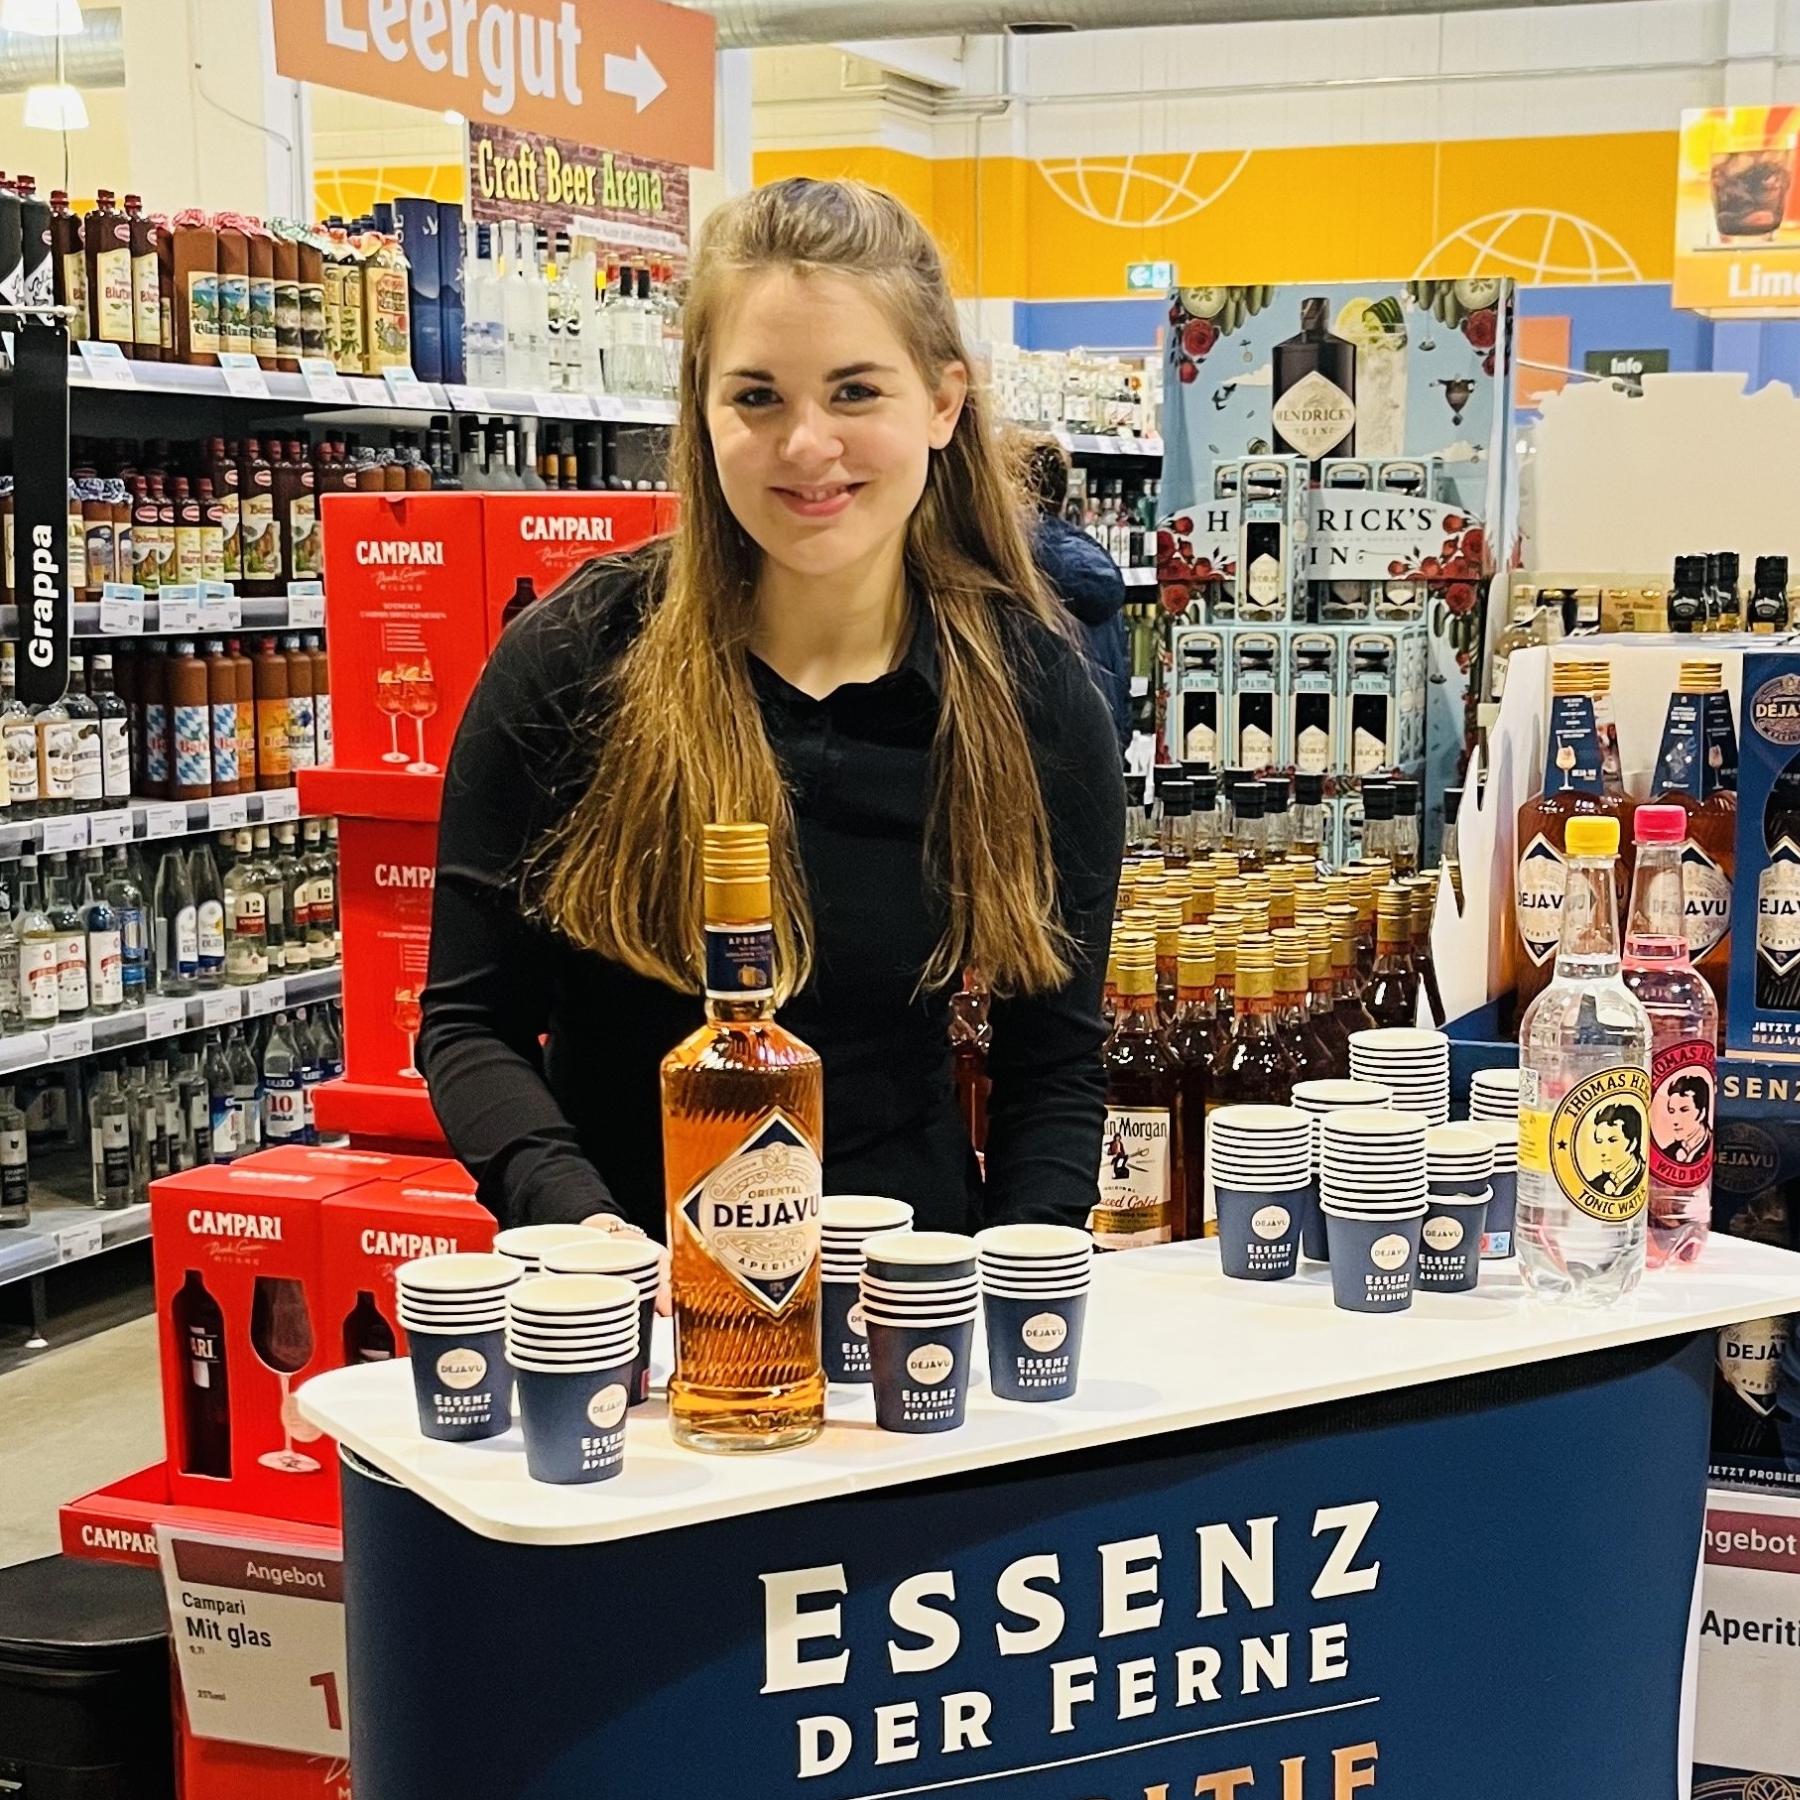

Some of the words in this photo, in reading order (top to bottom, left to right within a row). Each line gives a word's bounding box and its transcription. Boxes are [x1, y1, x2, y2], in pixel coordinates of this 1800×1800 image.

[326, 0, 582, 114] Leergut
[478, 139, 539, 202] Craft
[543, 147, 597, 207] Beer
[601, 153, 663, 210] Arena
[1610, 357, 1643, 374] Info
[520, 516, 614, 542] CAMPARI
[1207, 508, 1432, 532] HRICK'S
[356, 541, 445, 566] CAMPARI
[1310, 547, 1349, 564] IN
[28, 525, 60, 667] Grappa
[375, 863, 436, 889] CAMP
[269, 1095, 293, 1112] 10
[1564, 1073, 1626, 1118] THOMAS
[1119, 1117, 1168, 1140] Morgan
[1656, 1160, 1686, 1180] WILD
[1578, 1189, 1615, 1214] TONIC
[188, 1210, 282, 1241] CAMPARI
[361, 1229, 457, 1257] CAMPARI
[1247, 1243, 1291, 1254] ESSENZ
[1418, 1254, 1466, 1265] ESSENZ
[1365, 1273, 1410, 1285] ESSENZ
[1017, 1355, 1069, 1368] ESSENZ
[434, 1393, 492, 1406] ESSENZ
[902, 1388, 956, 1402] ESSENZ
[82, 1525, 158, 1556] CAMPAR
[246, 1562, 326, 1588] Angebot
[182, 1592, 246, 1616] Campari
[758, 1501, 1380, 1694] ESSENZ
[186, 1617, 222, 1642] Mit
[227, 1623, 272, 1648] glas
[310, 1672, 342, 1730] 1
[796, 1690, 992, 1778] DER
[1049, 1623, 1349, 1734] FERNE
